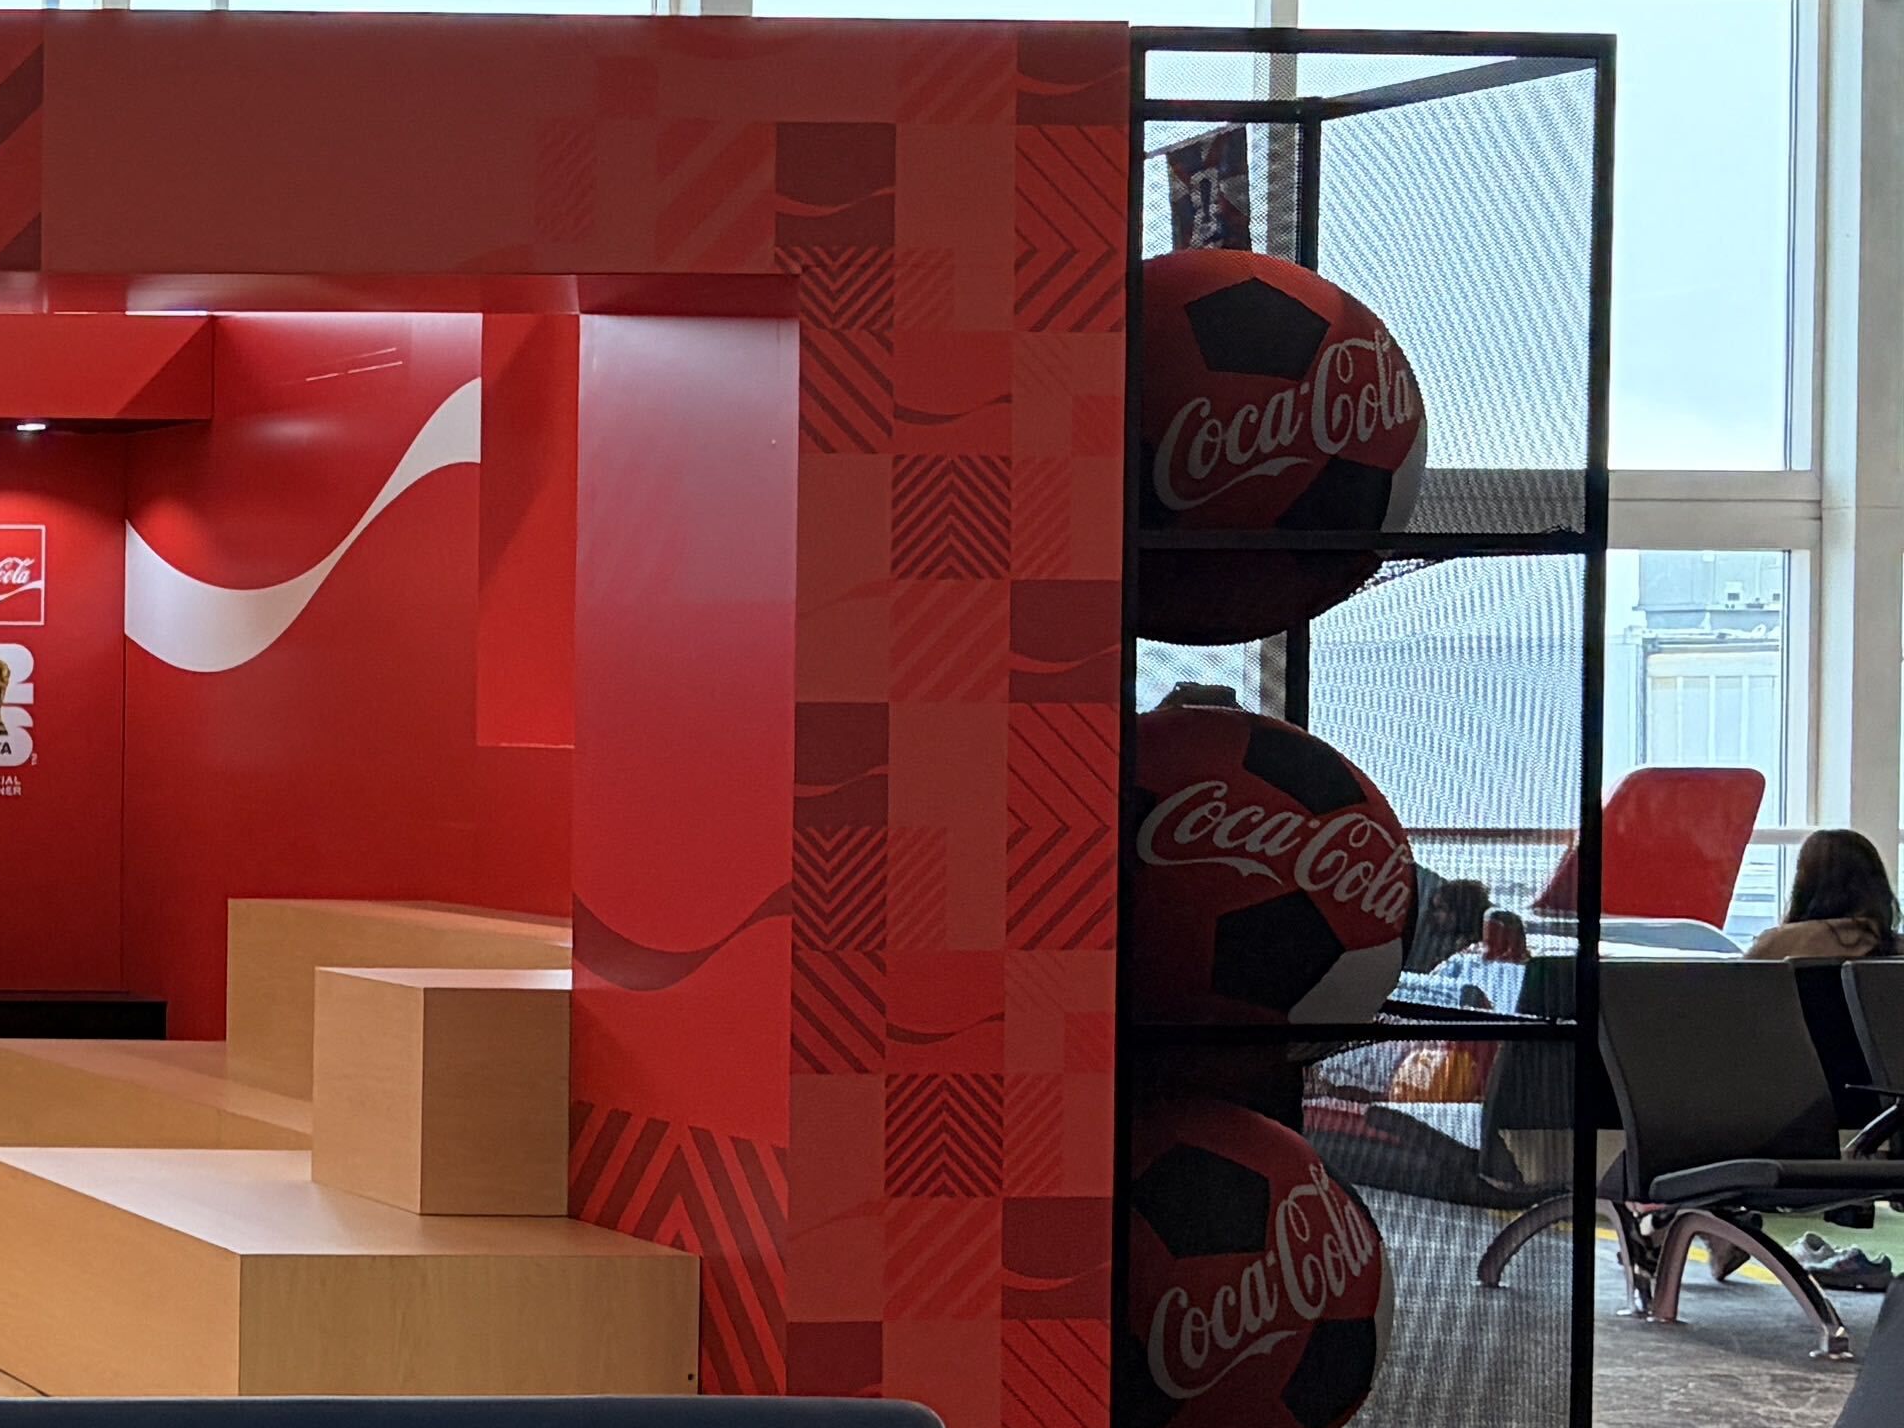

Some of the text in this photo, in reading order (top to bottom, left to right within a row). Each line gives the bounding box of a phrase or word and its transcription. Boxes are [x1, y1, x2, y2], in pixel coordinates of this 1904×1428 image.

[1153, 328, 1413, 510] Coca-Cola
[1136, 780, 1413, 925] Coca-Cola
[1148, 1162, 1377, 1400] Coca-Cola
